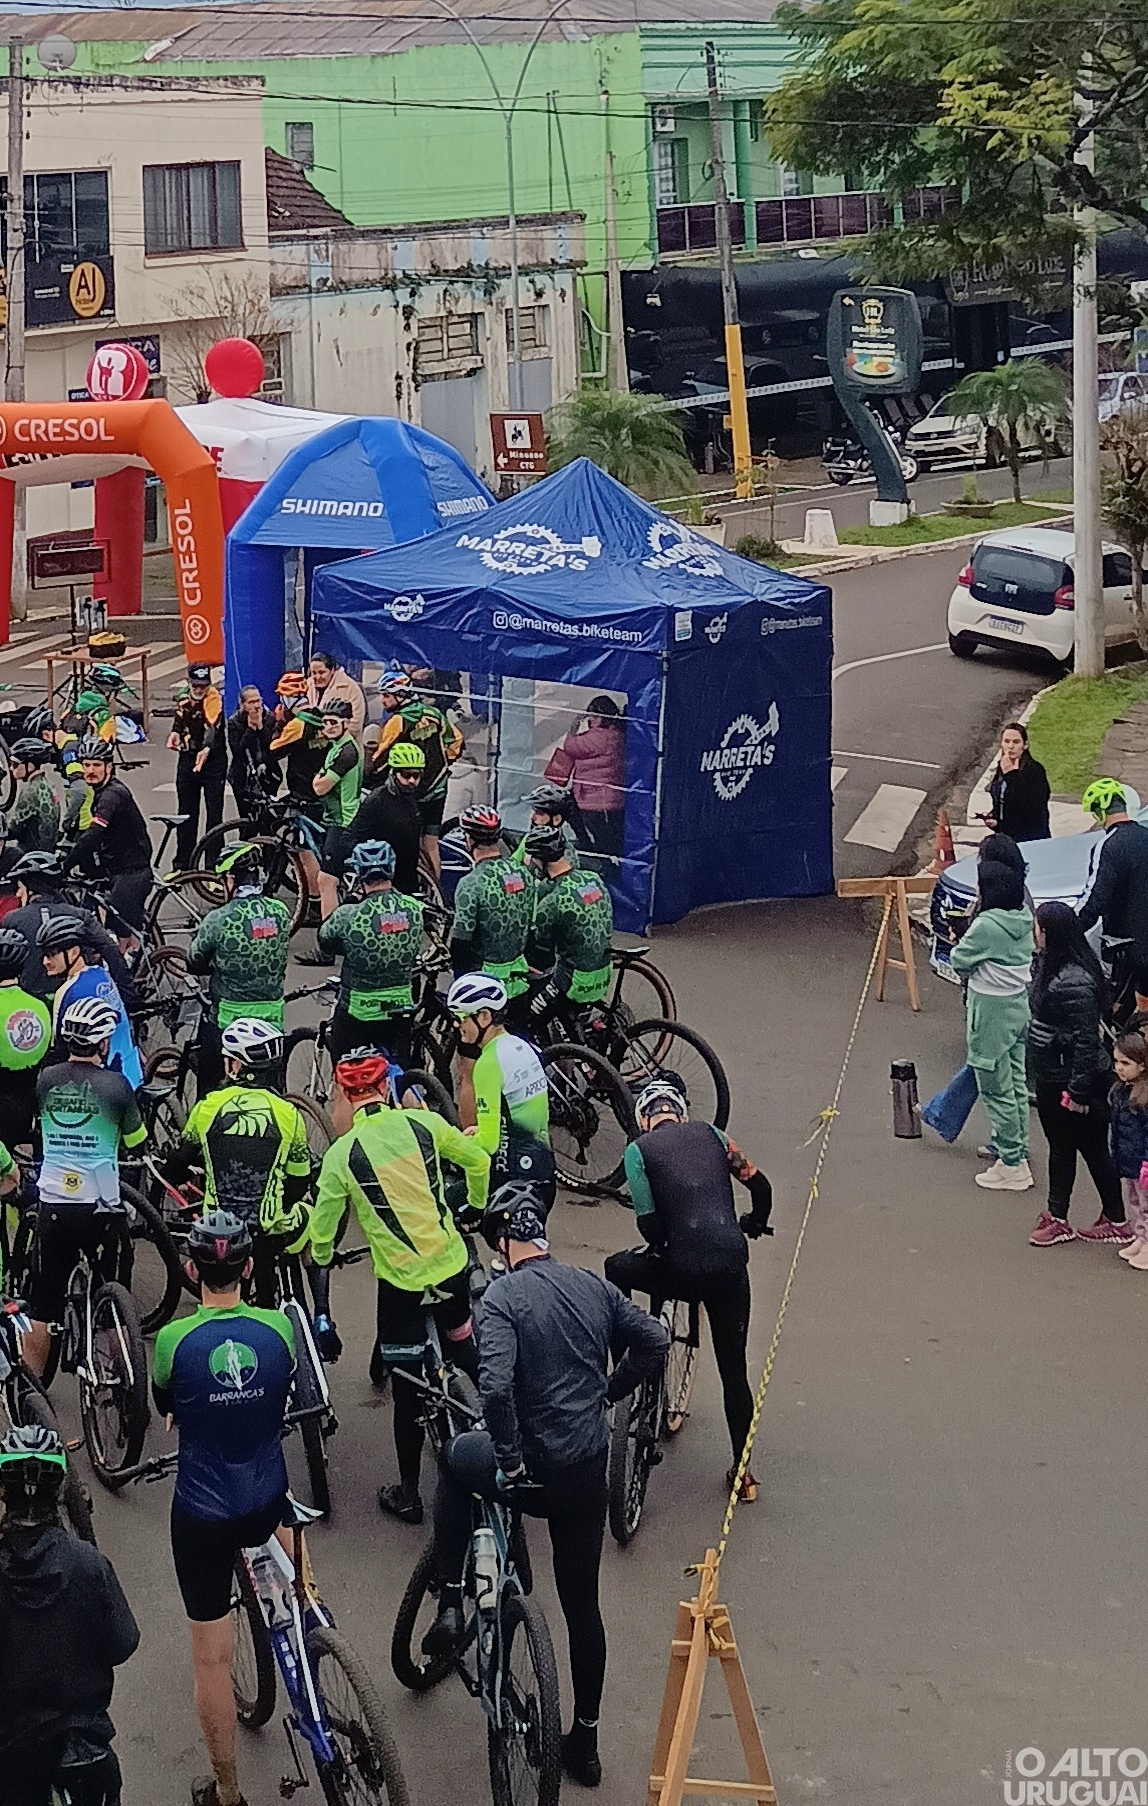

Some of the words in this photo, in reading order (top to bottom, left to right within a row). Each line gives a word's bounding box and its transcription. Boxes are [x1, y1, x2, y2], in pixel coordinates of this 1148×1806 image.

[76, 266, 96, 303] AJ
[14, 418, 115, 442] CRESOL
[519, 461, 535, 470] CTG
[280, 498, 384, 517] SHIMANO
[437, 495, 490, 518] SHIMANO
[175, 498, 202, 606] CRESOL
[455, 534, 590, 572] MARRETA'S
[509, 614, 643, 642] @marretas.biketeam
[700, 741, 776, 773] MARRETA'S
